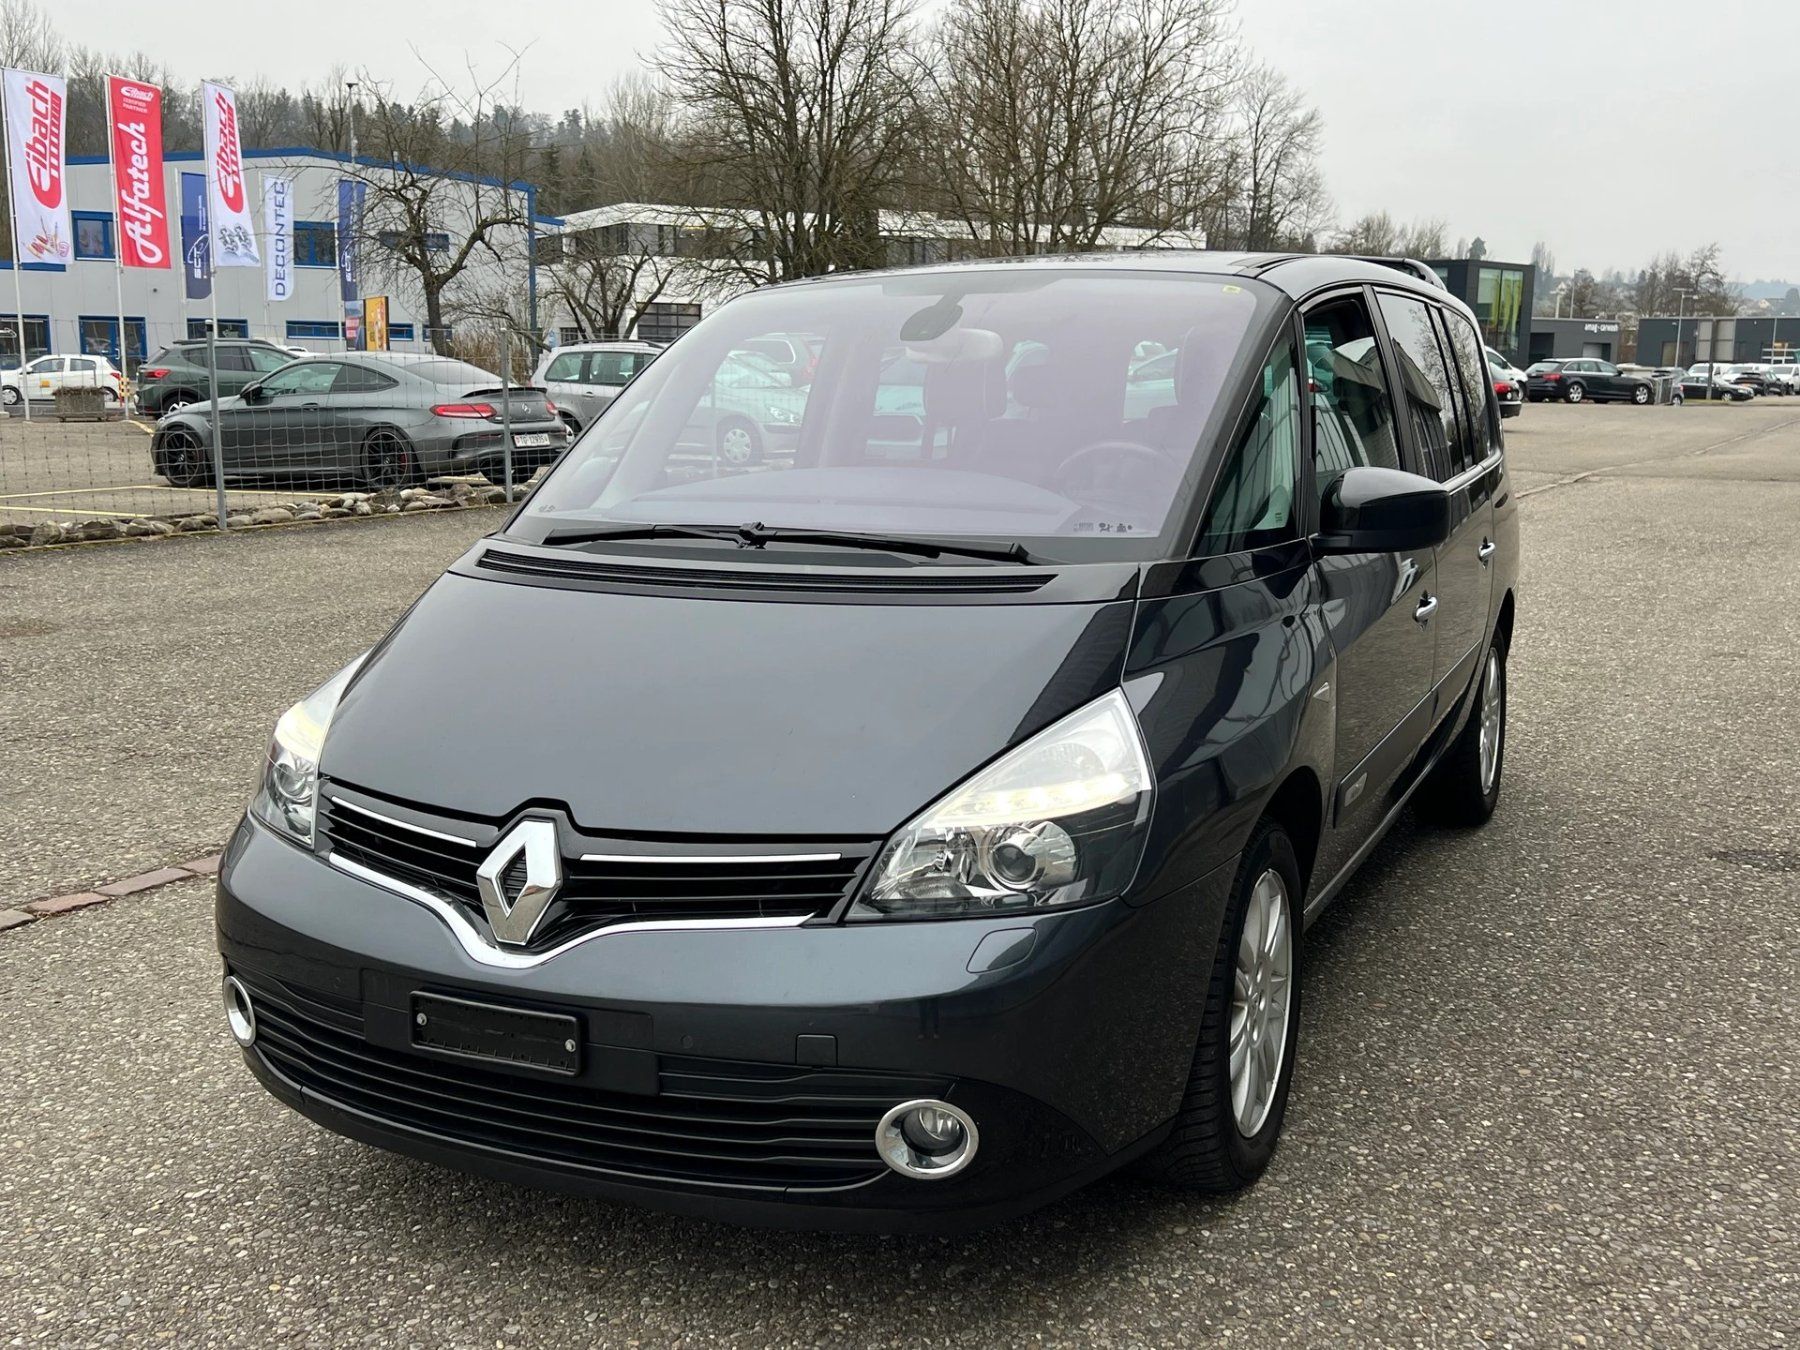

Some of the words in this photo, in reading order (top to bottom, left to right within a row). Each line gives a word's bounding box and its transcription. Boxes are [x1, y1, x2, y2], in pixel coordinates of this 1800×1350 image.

[25, 80, 62, 209] Eibach
[117, 122, 163, 264] Alfatech
[275, 181, 286, 297] DECONTEC
